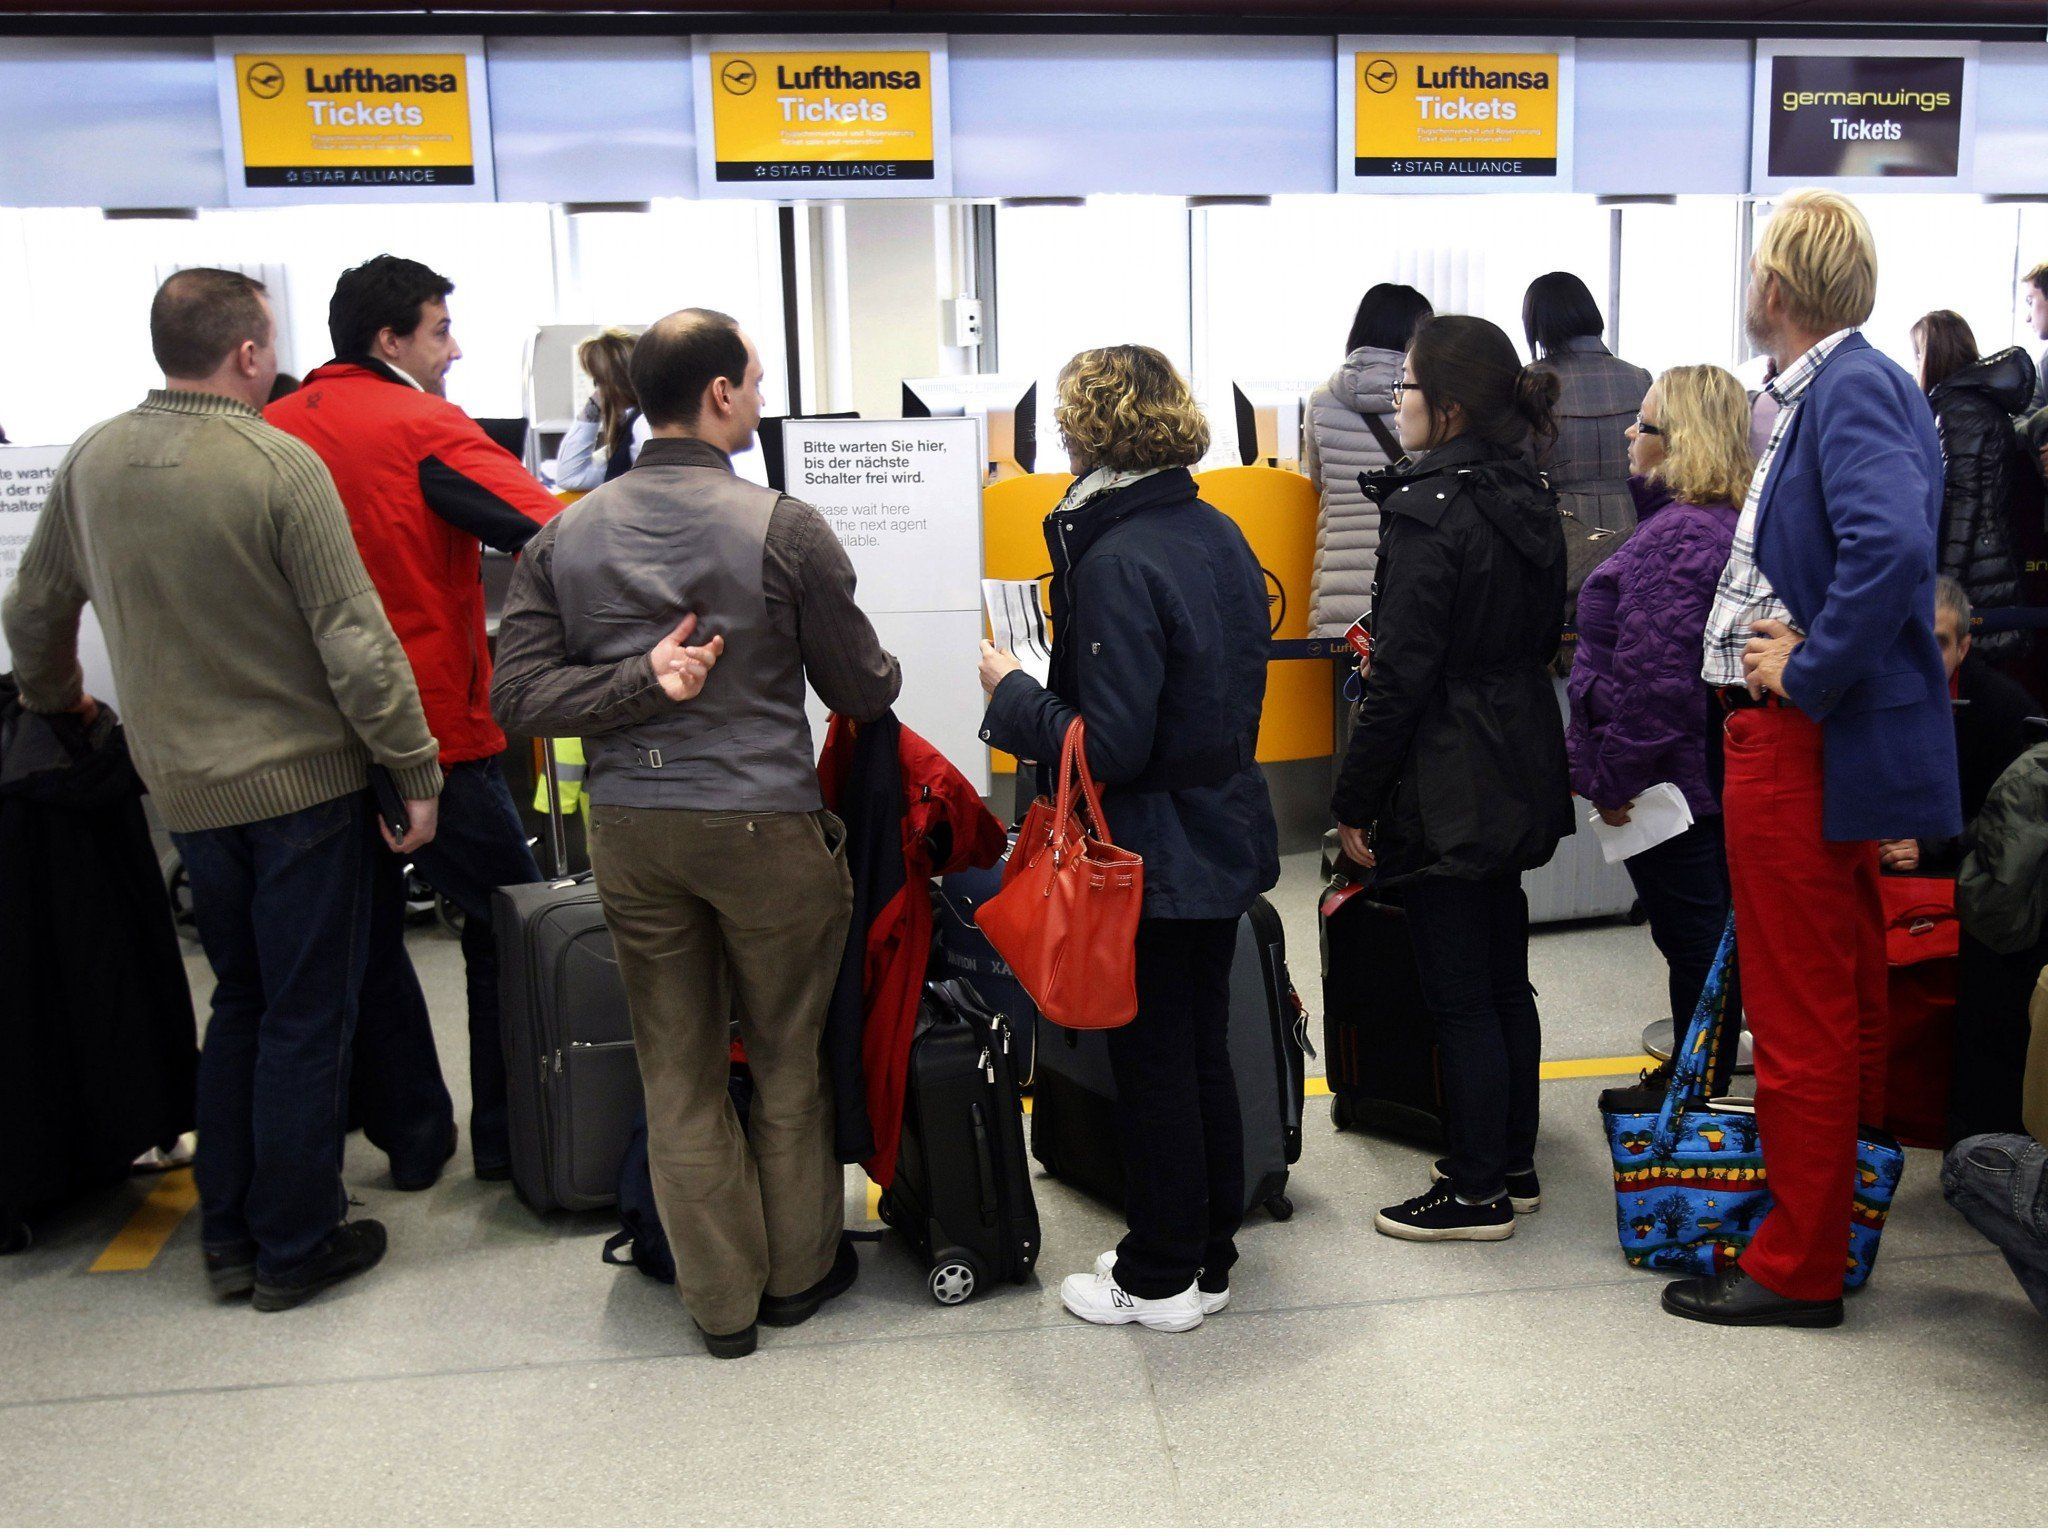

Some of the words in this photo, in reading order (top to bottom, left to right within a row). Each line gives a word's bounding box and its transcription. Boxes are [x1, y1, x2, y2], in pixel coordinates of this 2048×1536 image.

[306, 68, 457, 93] Lufthansa
[777, 66, 921, 89] Lufthansa
[1416, 66, 1549, 89] Lufthansa
[1782, 89, 1950, 111] germanwings
[306, 101, 423, 126] Tickets
[777, 97, 888, 122] Tickets
[1416, 96, 1517, 120] Tickets
[1830, 118, 1901, 140] Tickets
[770, 166, 811, 178] STAR
[817, 165, 896, 177] ALLIANCE
[1405, 161, 1443, 173] STAR
[1450, 161, 1522, 173] ALLIANCE
[303, 170, 346, 183] STAR
[352, 170, 436, 182] ALLIANCE
[803, 441, 836, 453] Bitte
[839, 442, 887, 453] warten
[891, 440, 914, 452] Sie
[917, 440, 947, 454] hier,
[804, 457, 825, 469] bis
[828, 457, 851, 468] der
[855, 456, 910, 468] nächste
[804, 472, 861, 485] Schalter
[866, 472, 888, 484] frei
[892, 472, 925, 484] wird.
[6, 484, 30, 496] der
[810, 503, 848, 516] ease
[852, 503, 878, 516] wait
[881, 503, 910, 515] here
[836, 519, 856, 531] the
[860, 520, 887, 531] next
[890, 519, 927, 534] agent
[838, 533, 880, 547] ailable.
[1110, 1288, 1134, 1308] N
